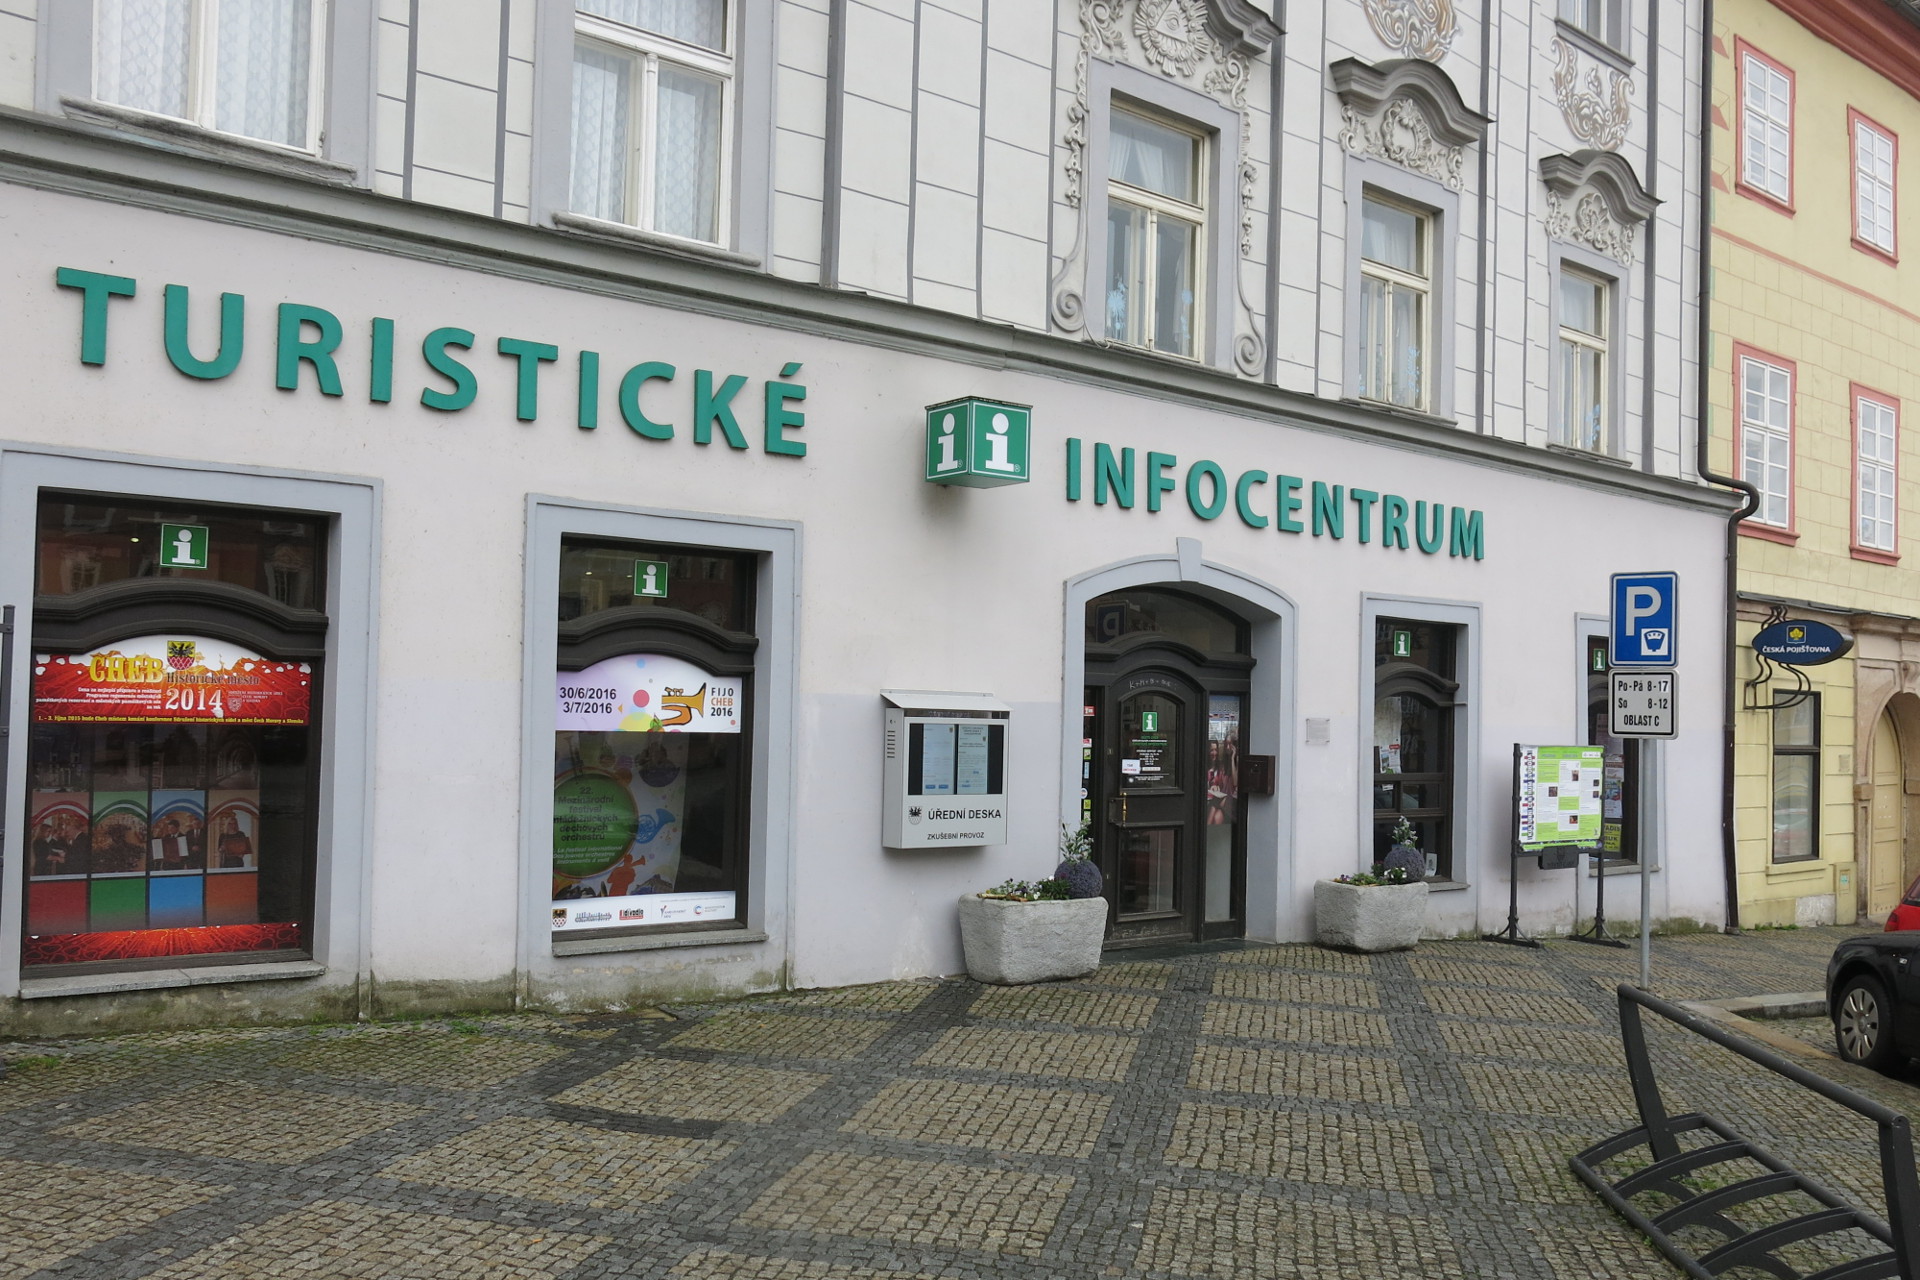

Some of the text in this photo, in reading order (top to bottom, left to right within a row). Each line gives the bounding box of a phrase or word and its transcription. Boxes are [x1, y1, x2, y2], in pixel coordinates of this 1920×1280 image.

[56, 266, 808, 457] TURISTICKÉ
[1066, 437, 1485, 561] INFOCENTRUM
[1626, 586, 1662, 636] P
[1763, 645, 1831, 654] ČESKÁ POJIŠŤOVNA
[90, 656, 163, 683] CHEB
[559, 687, 617, 700] 30/6/2016
[711, 687, 734, 697] FIJO
[165, 688, 223, 710] 2014
[711, 697, 734, 707] CHEB
[1618, 698, 1628, 709] So
[563, 702, 613, 714] 3/7/2016
[711, 707, 733, 717] 2016
[1624, 715, 1660, 727] OBLAST C
[928, 808, 1002, 820] ÚŘEDNÍ DESKA
[927, 832, 958, 840] ZKUŠEBNÍ
